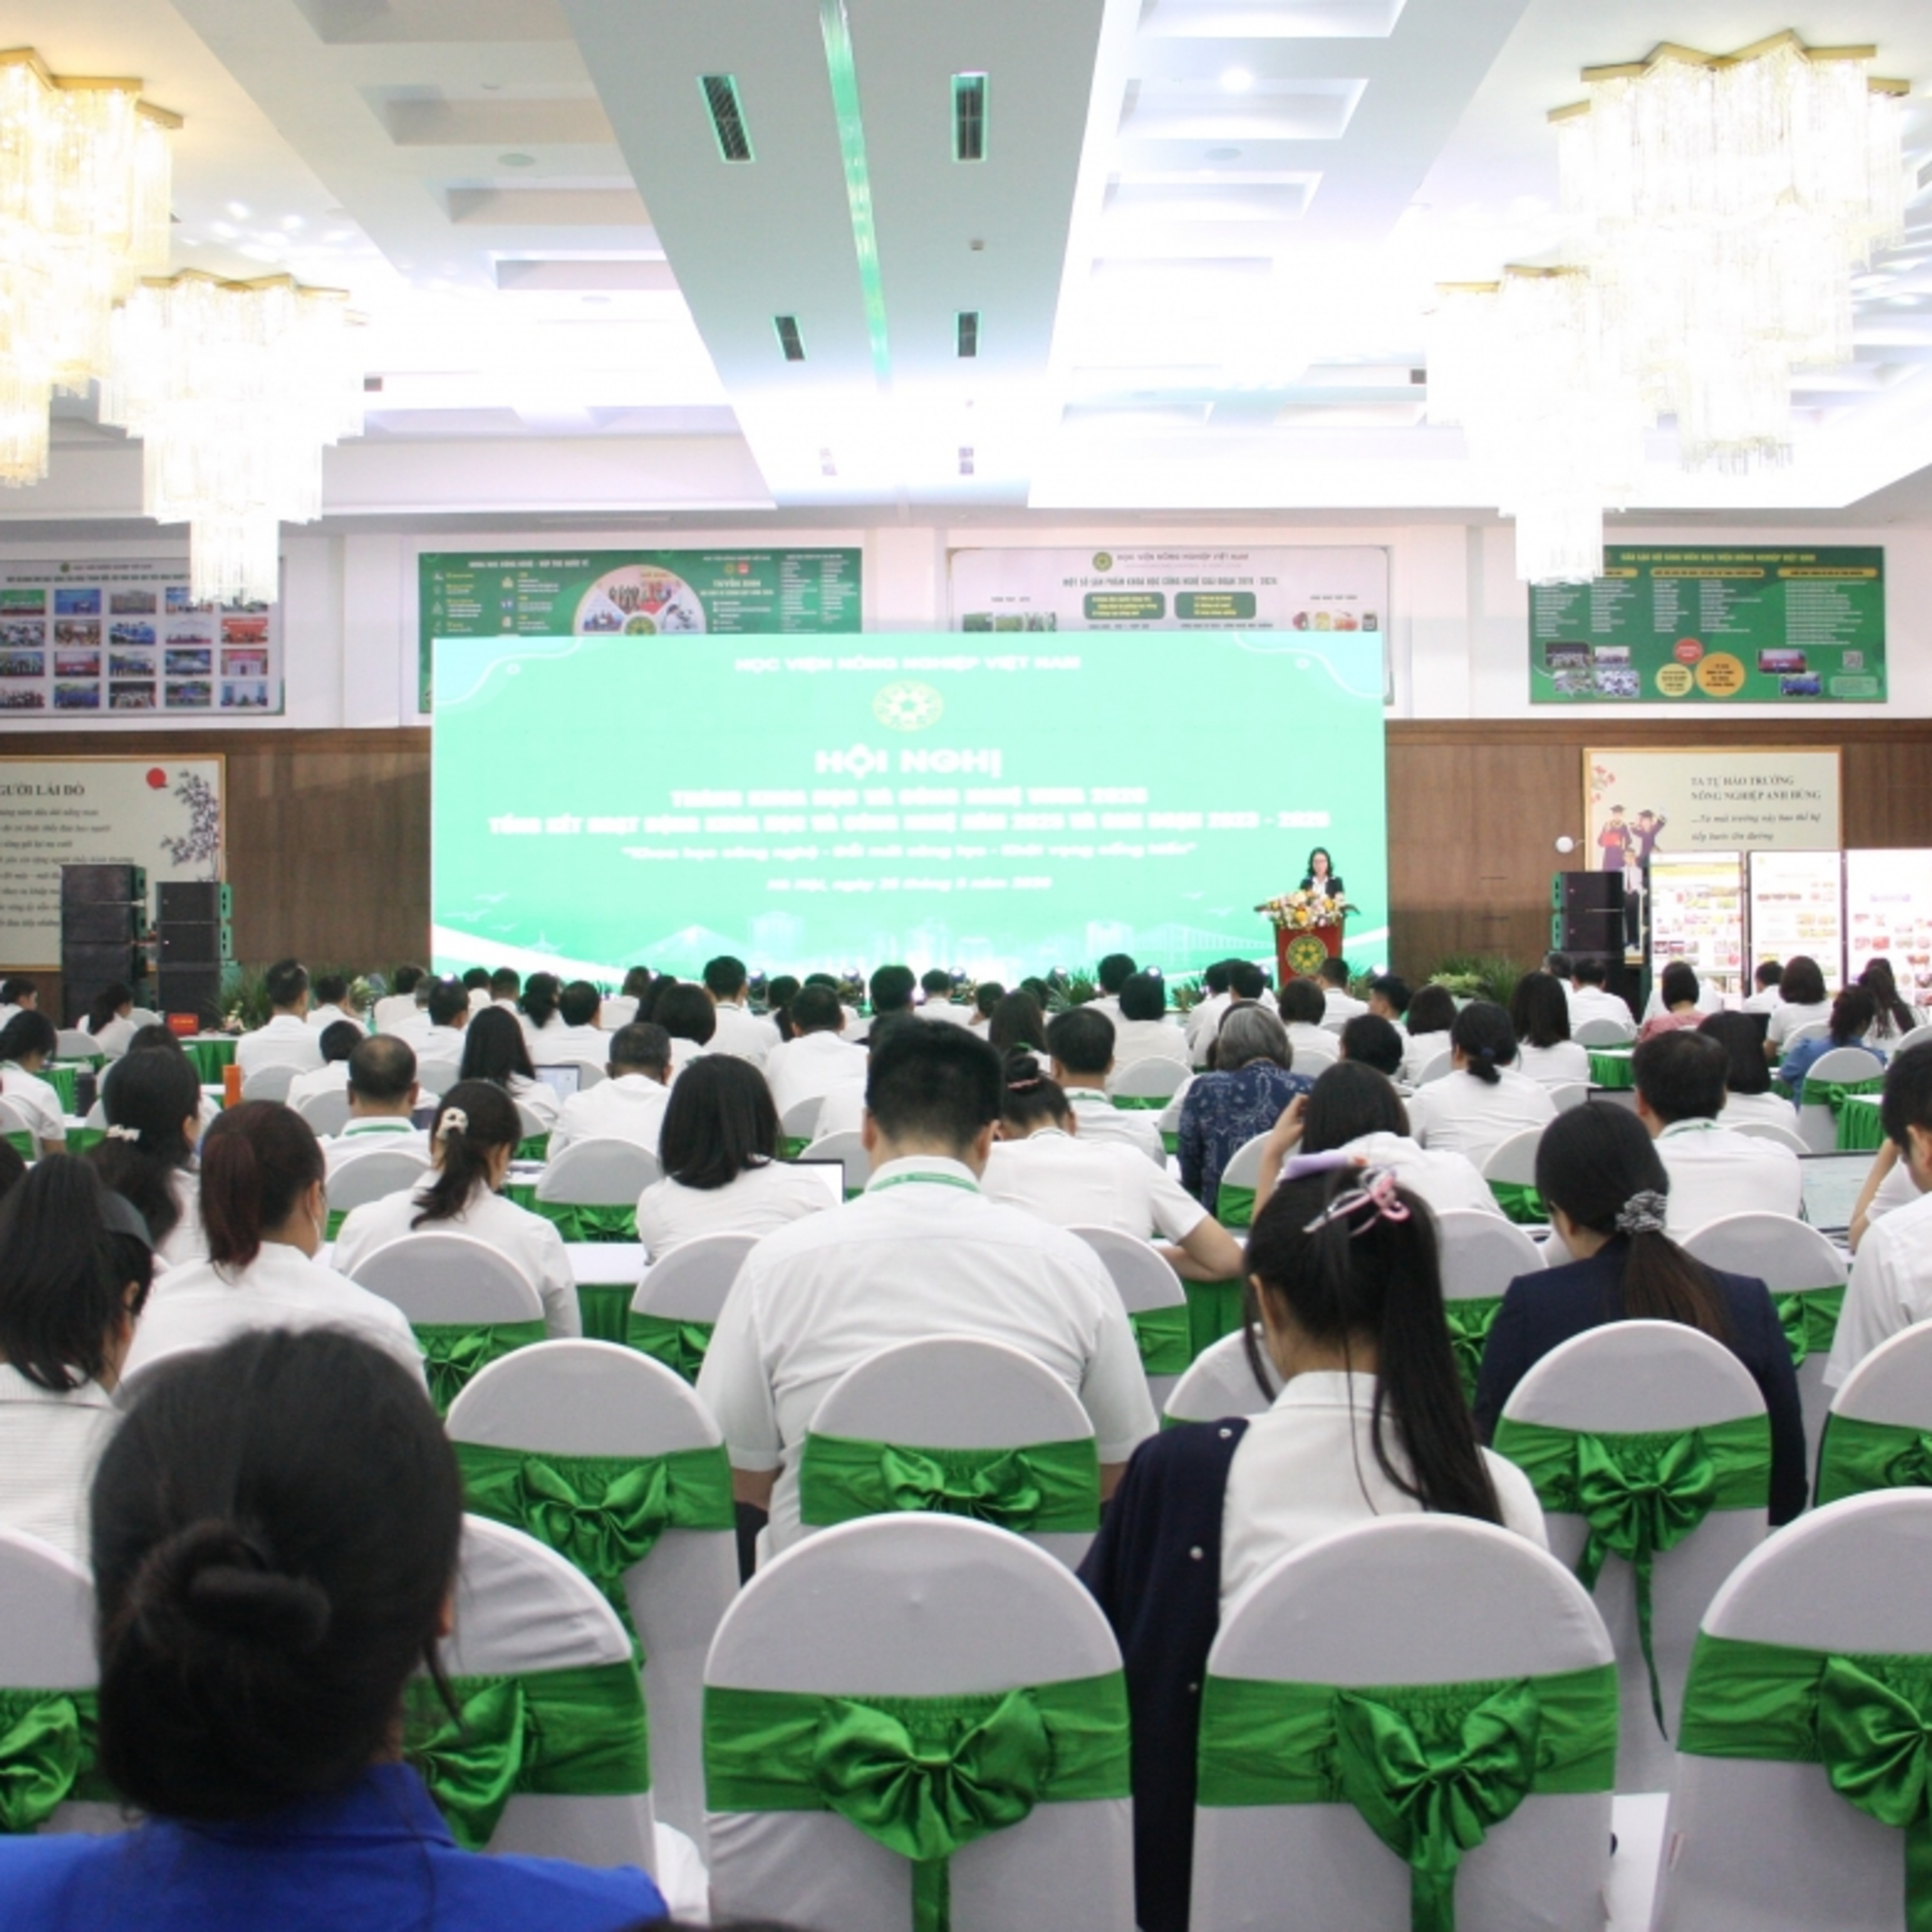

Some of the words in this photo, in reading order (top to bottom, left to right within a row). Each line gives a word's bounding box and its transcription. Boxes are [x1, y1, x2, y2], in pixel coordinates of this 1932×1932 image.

[816, 743, 887, 779] HỘI
[901, 749, 1001, 778] NGHỊ
[37, 781, 60, 795] LÁI
[64, 781, 85, 795] ĐÒ
[1691, 777, 1704, 786] TA
[1707, 776, 1721, 788] TỰ
[1723, 775, 1747, 786] HÀO
[1750, 775, 1794, 786] TRƯỜNG
[1691, 790, 1722, 800] NÔNG
[1724, 790, 1764, 802] NGHIỆP
[1766, 791, 1788, 800] ANH
[1790, 788, 1821, 800] HÙNG
